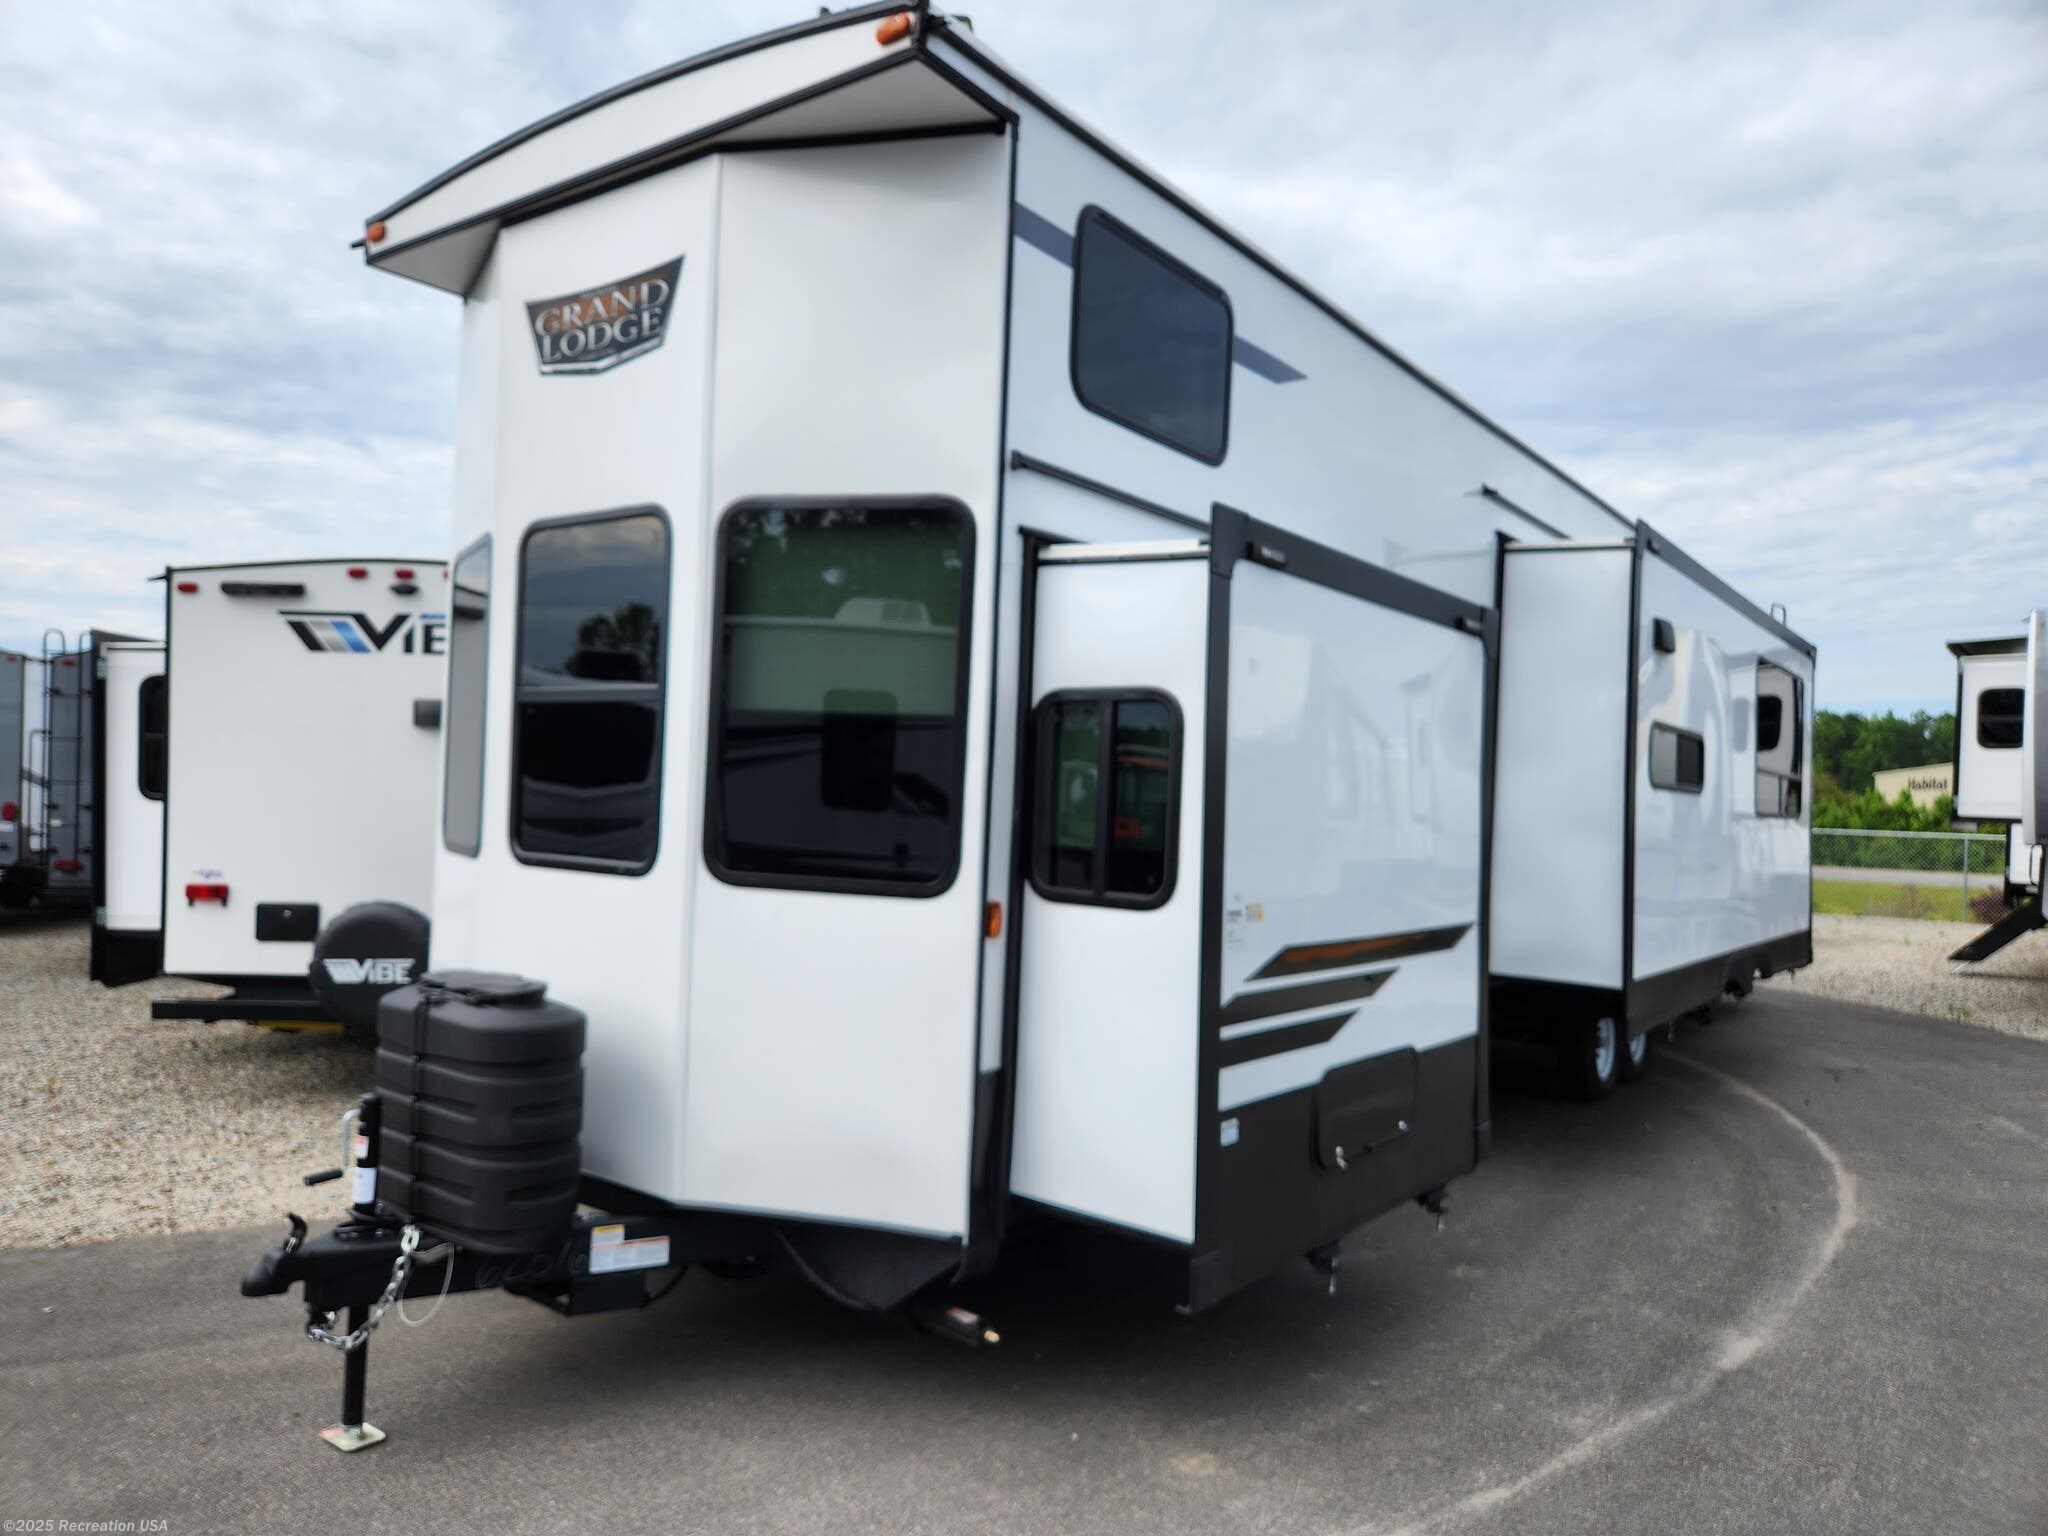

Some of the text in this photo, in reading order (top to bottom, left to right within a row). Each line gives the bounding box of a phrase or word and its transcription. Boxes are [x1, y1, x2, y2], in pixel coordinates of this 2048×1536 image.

[534, 278, 670, 338] GRAND
[541, 306, 664, 363] LODGE
[323, 958, 416, 985] VIBE
